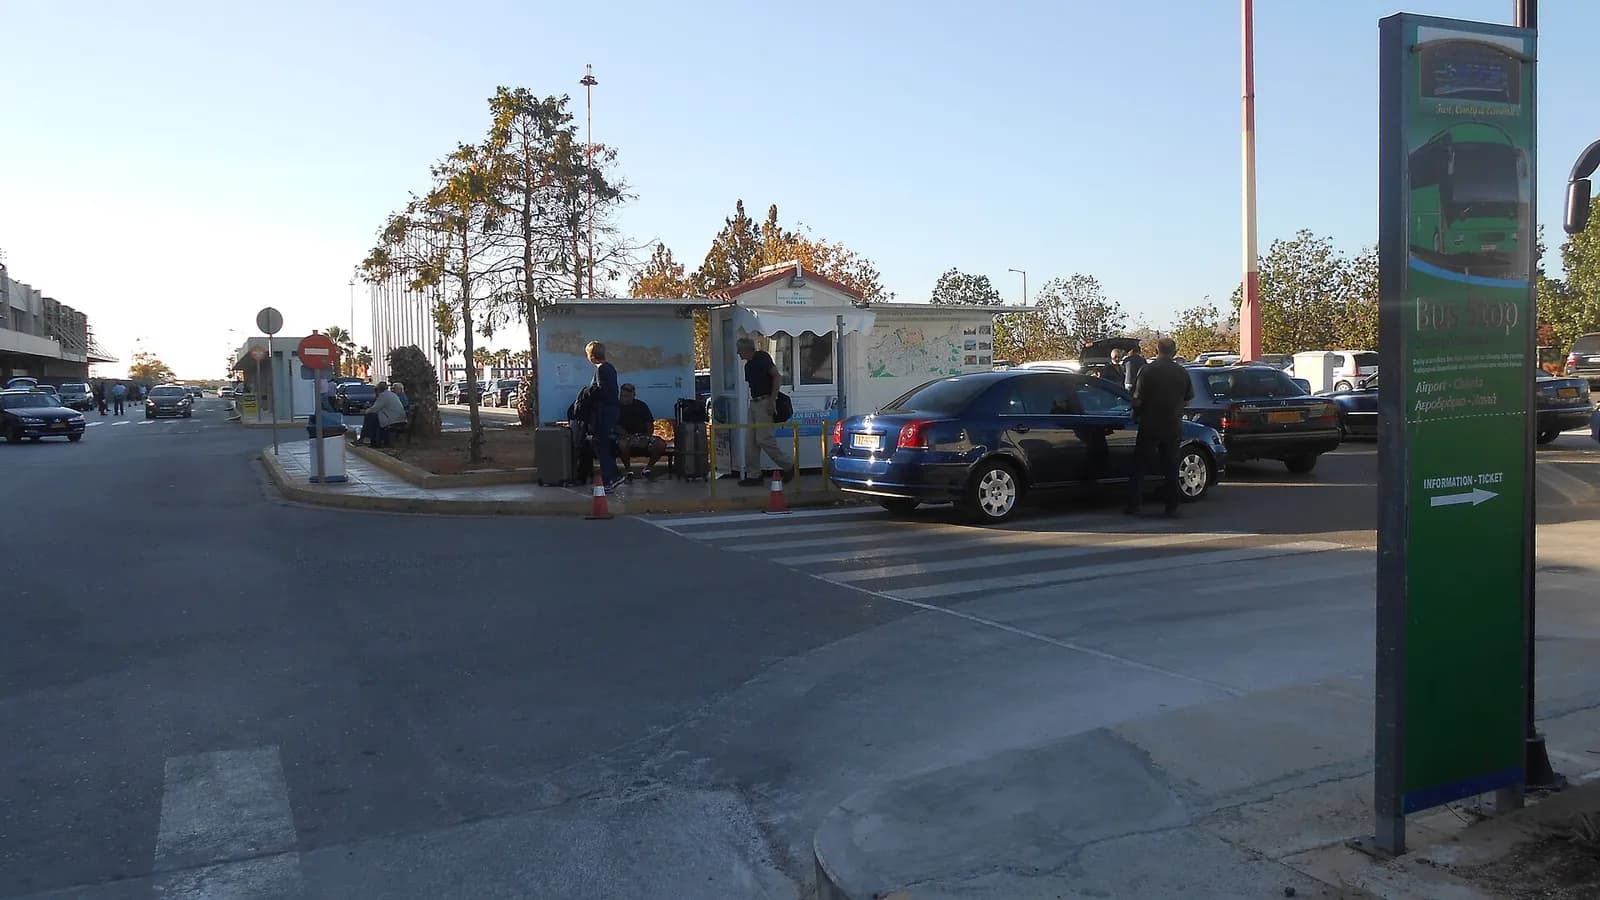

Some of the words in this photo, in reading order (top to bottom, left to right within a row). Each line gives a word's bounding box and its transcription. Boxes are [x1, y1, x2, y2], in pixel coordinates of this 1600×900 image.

[1416, 297, 1458, 331] Bus
[1415, 379, 1447, 395] Airport
[1423, 475, 1473, 489] INFORMATION
[1478, 472, 1503, 484] TICKET
